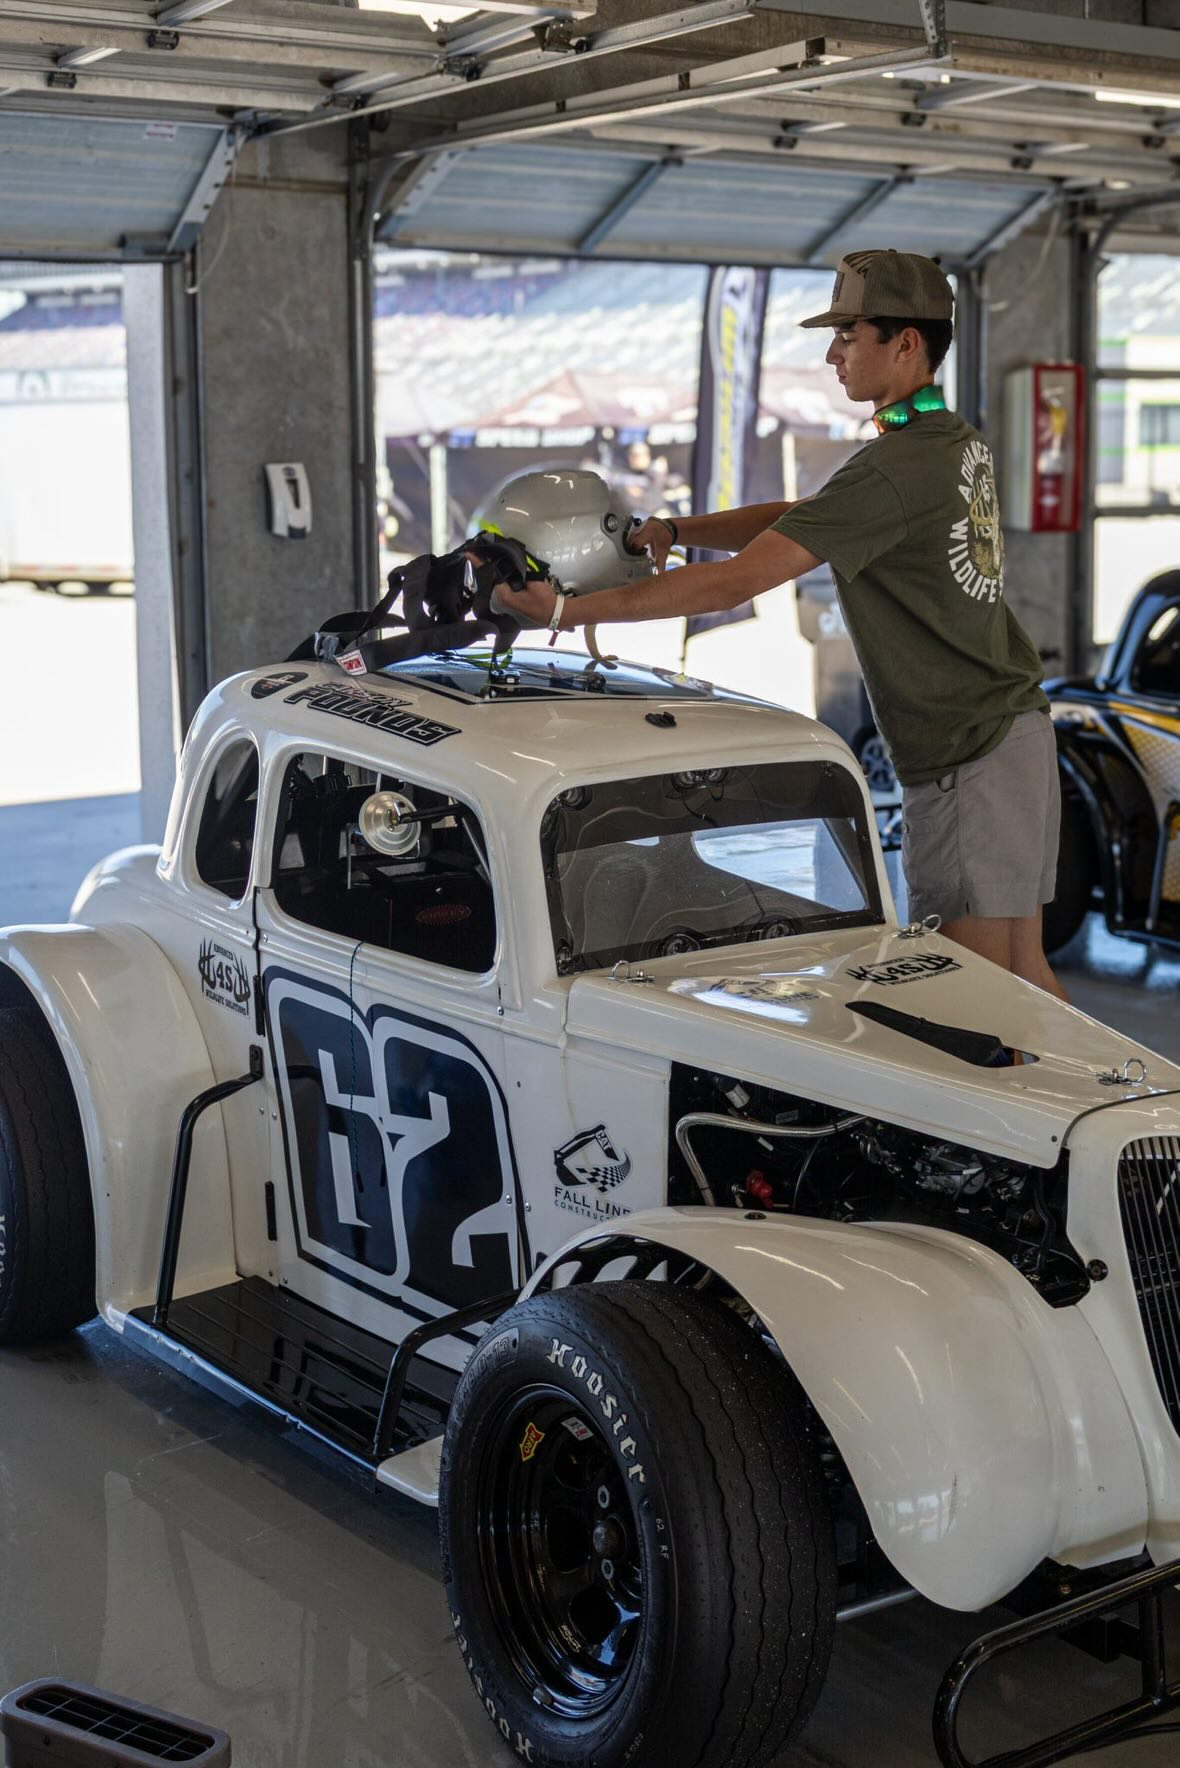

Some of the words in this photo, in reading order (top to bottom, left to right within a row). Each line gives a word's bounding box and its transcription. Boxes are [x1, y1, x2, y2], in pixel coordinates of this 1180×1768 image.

[947, 516, 998, 603] WILDLIFE
[284, 687, 462, 746] POUNDS
[263, 967, 525, 1325] 62
[595, 1129, 613, 1151] CAT
[554, 1186, 591, 1208] FALL
[554, 1200, 611, 1222] CONSTRUC
[546, 1338, 647, 1484] Hoosier
[522, 1431, 541, 1456] AERO
[655, 1518, 665, 1532] 62
[660, 1545, 670, 1560] RF
